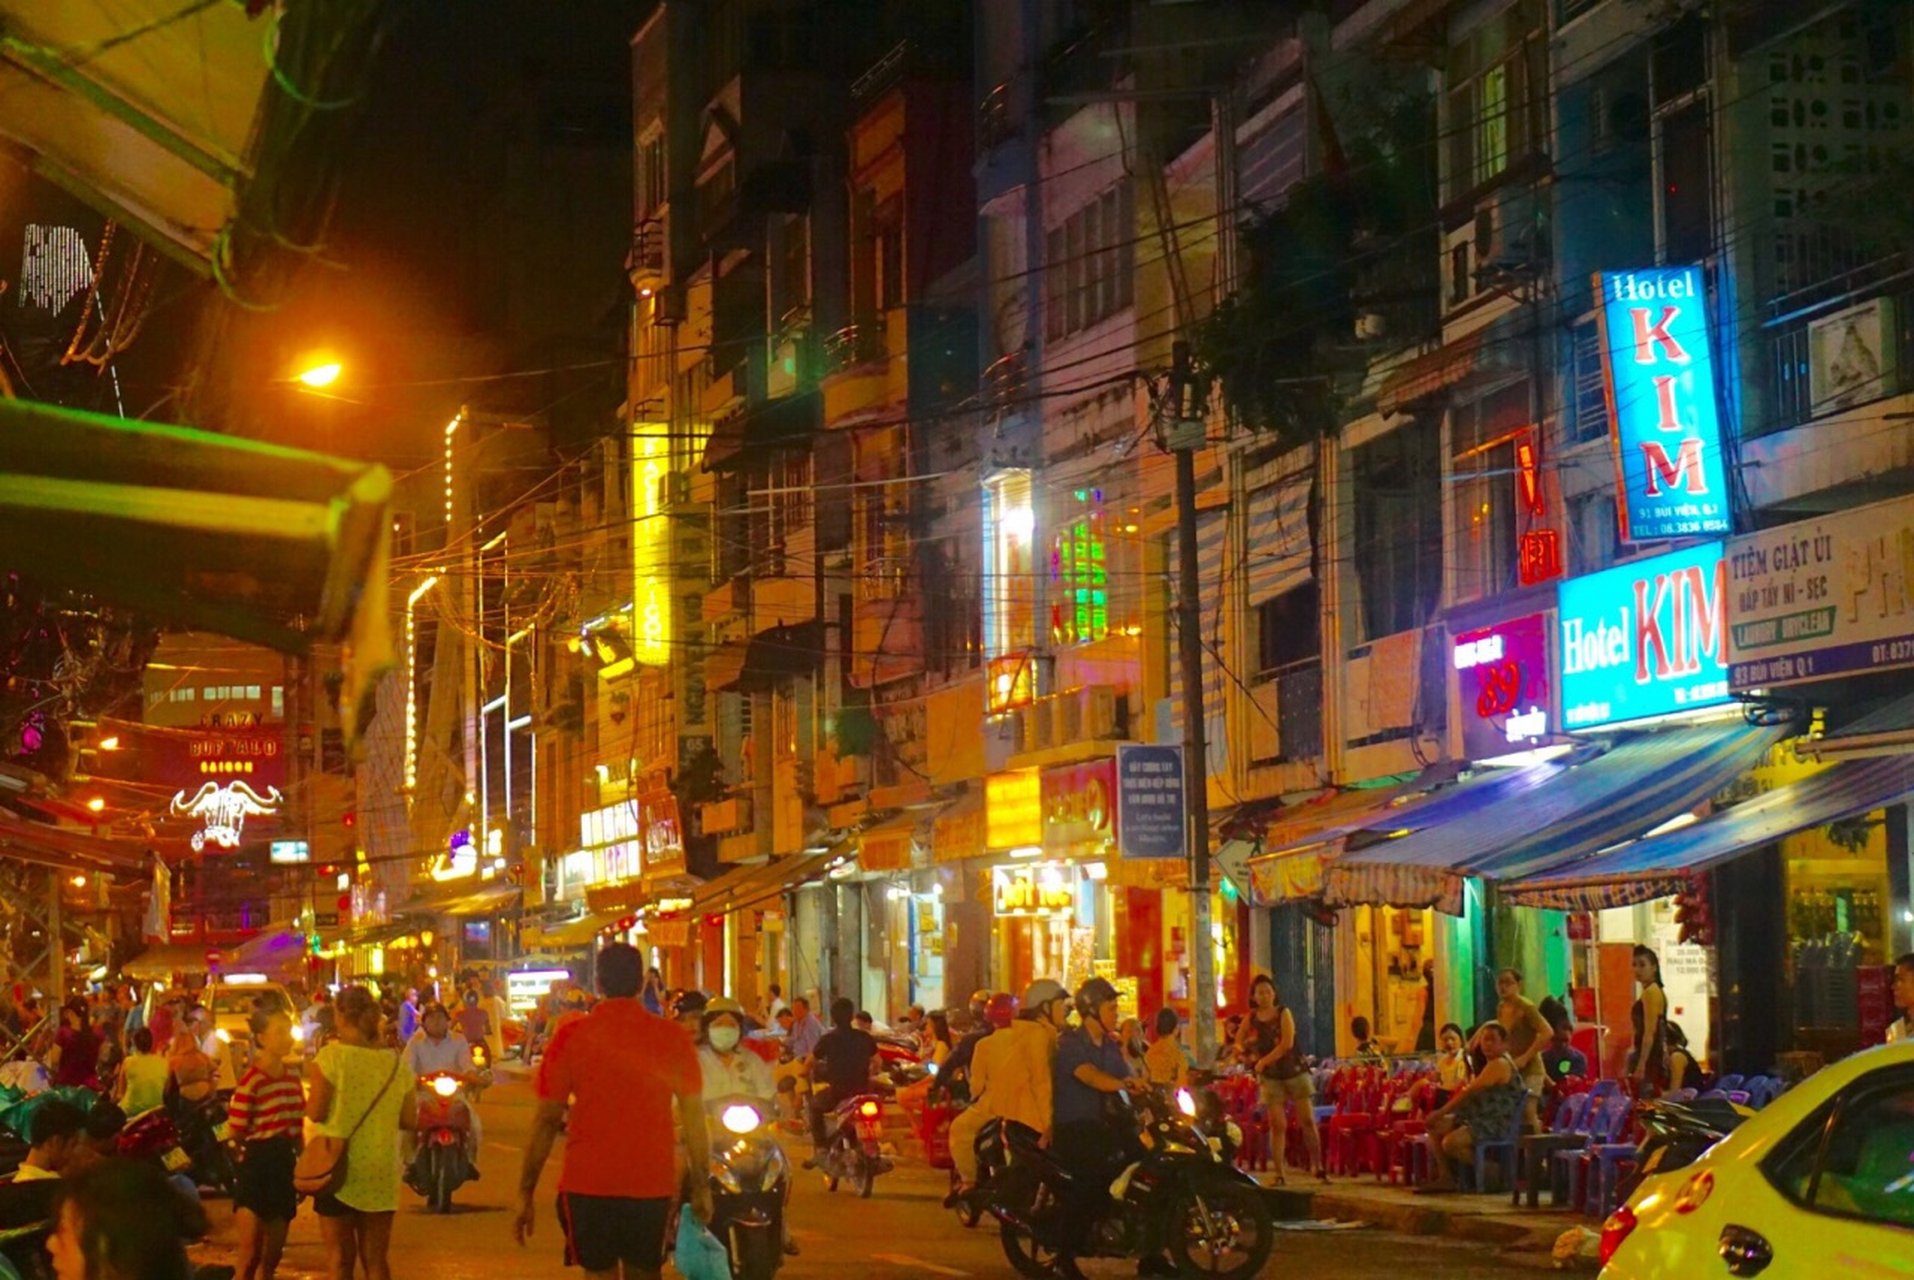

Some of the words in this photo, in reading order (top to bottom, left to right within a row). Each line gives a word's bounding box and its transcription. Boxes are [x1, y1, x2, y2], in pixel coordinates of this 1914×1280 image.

[1612, 270, 1695, 301] Hotel
[1629, 306, 1708, 496] KIM
[1731, 545, 1767, 582] TIỆM
[1561, 606, 1630, 674] Hotel
[1632, 559, 1728, 684] KIM
[1735, 666, 1750, 685] 93
[1750, 660, 1768, 682] BÙI
[1770, 657, 1794, 680] VIỆN
[1477, 661, 1520, 719] 89
[200, 713, 264, 728] CRAZY
[190, 740, 277, 756] BUFFALO
[686, 738, 704, 751] 65
